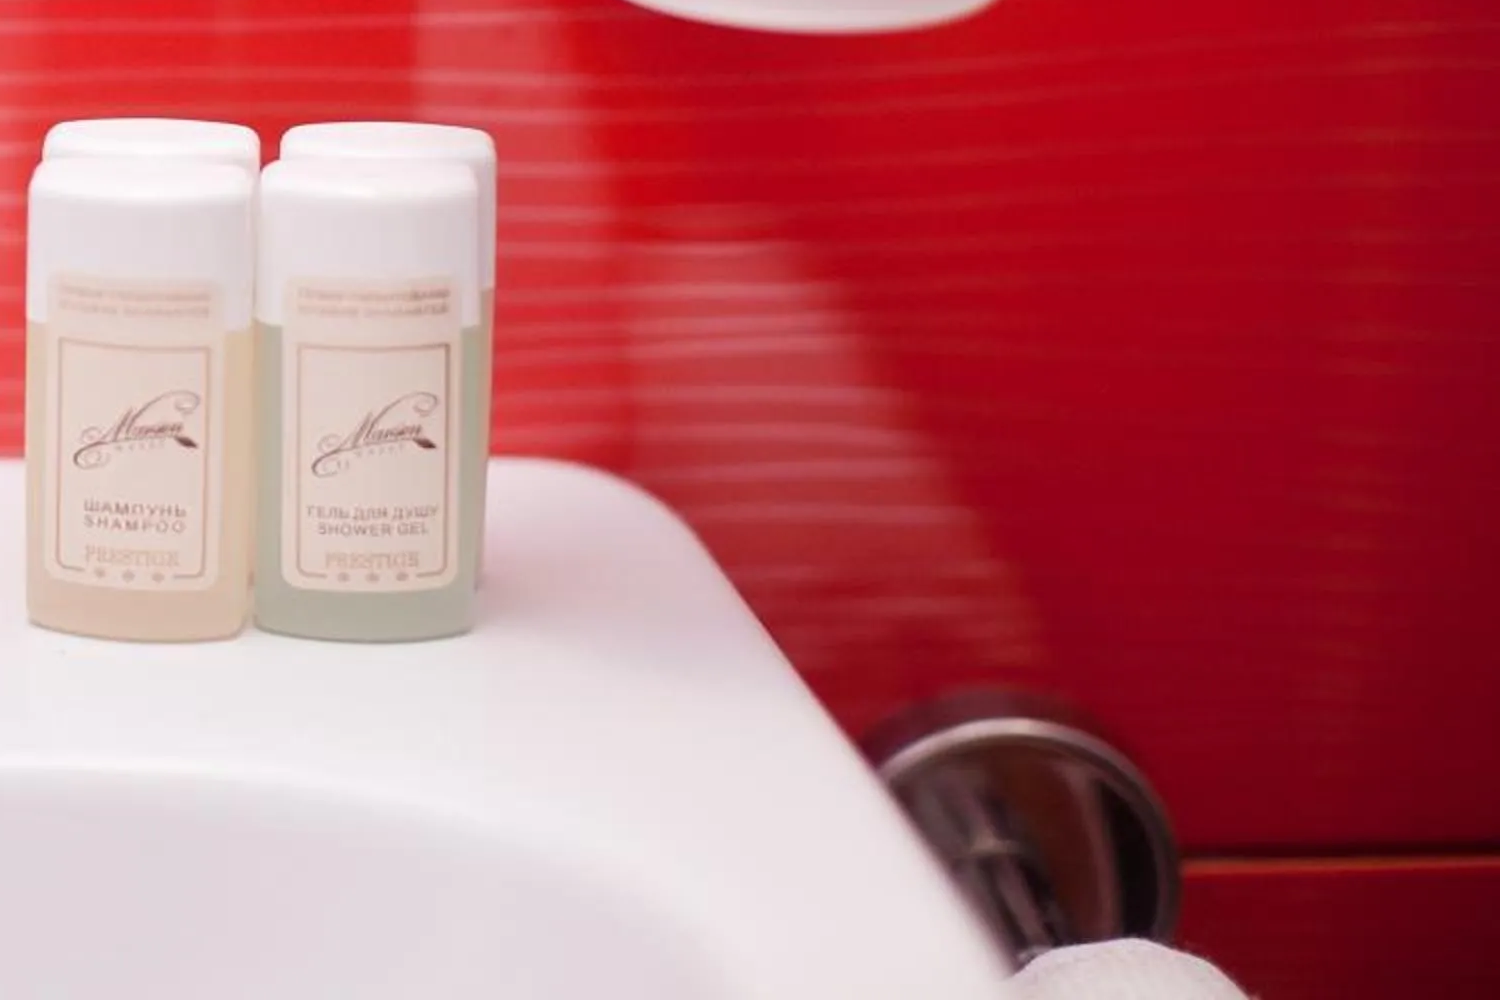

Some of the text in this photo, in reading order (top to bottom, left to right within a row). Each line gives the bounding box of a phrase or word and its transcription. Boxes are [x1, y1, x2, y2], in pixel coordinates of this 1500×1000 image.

[83, 499, 187, 517] ШАМПУНЬ
[306, 505, 350, 520] ГЕЛЬ
[392, 506, 438, 521] ДУШУ
[83, 514, 187, 534] SHAMPOO
[318, 521, 429, 537] SHOWER GEL
